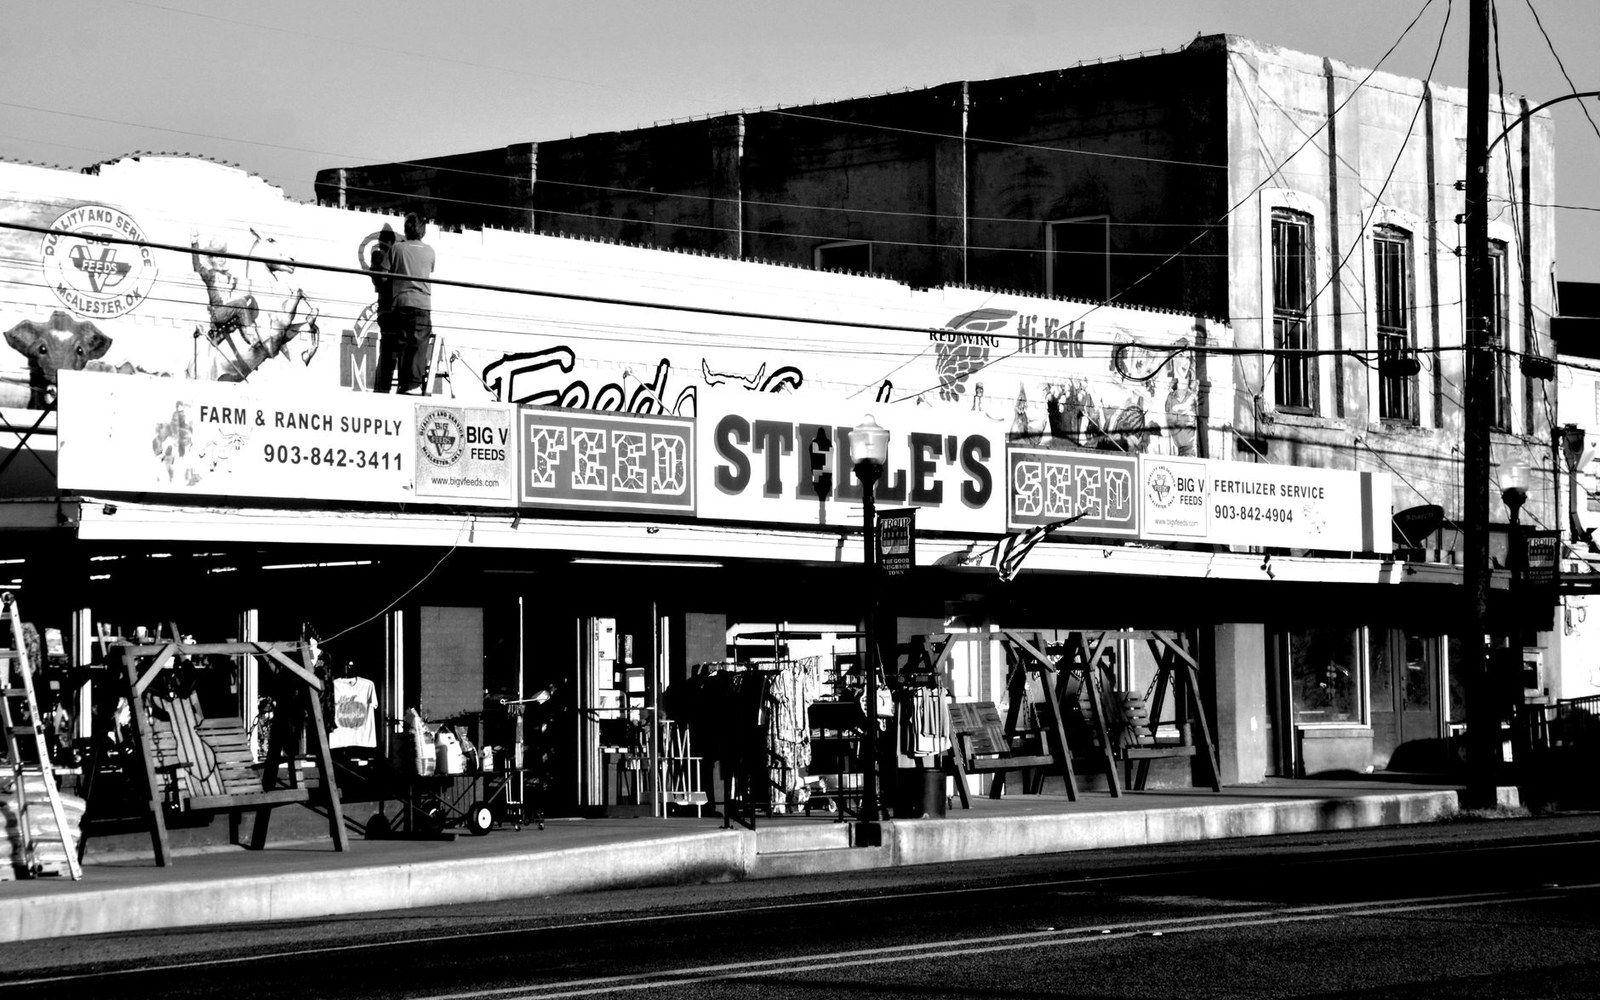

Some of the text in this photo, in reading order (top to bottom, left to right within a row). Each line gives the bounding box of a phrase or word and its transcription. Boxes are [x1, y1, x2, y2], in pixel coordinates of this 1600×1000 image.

[87, 209, 113, 223] AND
[115, 215, 152, 267] SERCE
[82, 259, 117, 275] FEEDS
[928, 327, 1000, 348] RED WING
[200, 405, 402, 436] FARM & RANCH SUPPLY
[466, 425, 509, 446] BIG V
[264, 443, 401, 471] 903-842-3411
[470, 447, 506, 462] FEEDS
[530, 425, 687, 496] FEED
[430, 476, 500, 488] www.bigvfeeds.com
[1014, 460, 1132, 522] SEED
[1177, 477, 1205, 493] BIG V
[1214, 479, 1324, 500] FERTILIZER SERVICE
[1180, 495, 1202, 506] FEEDS
[880, 517, 911, 529] TROUP
[1214, 504, 1293, 523] 903-842-4904
